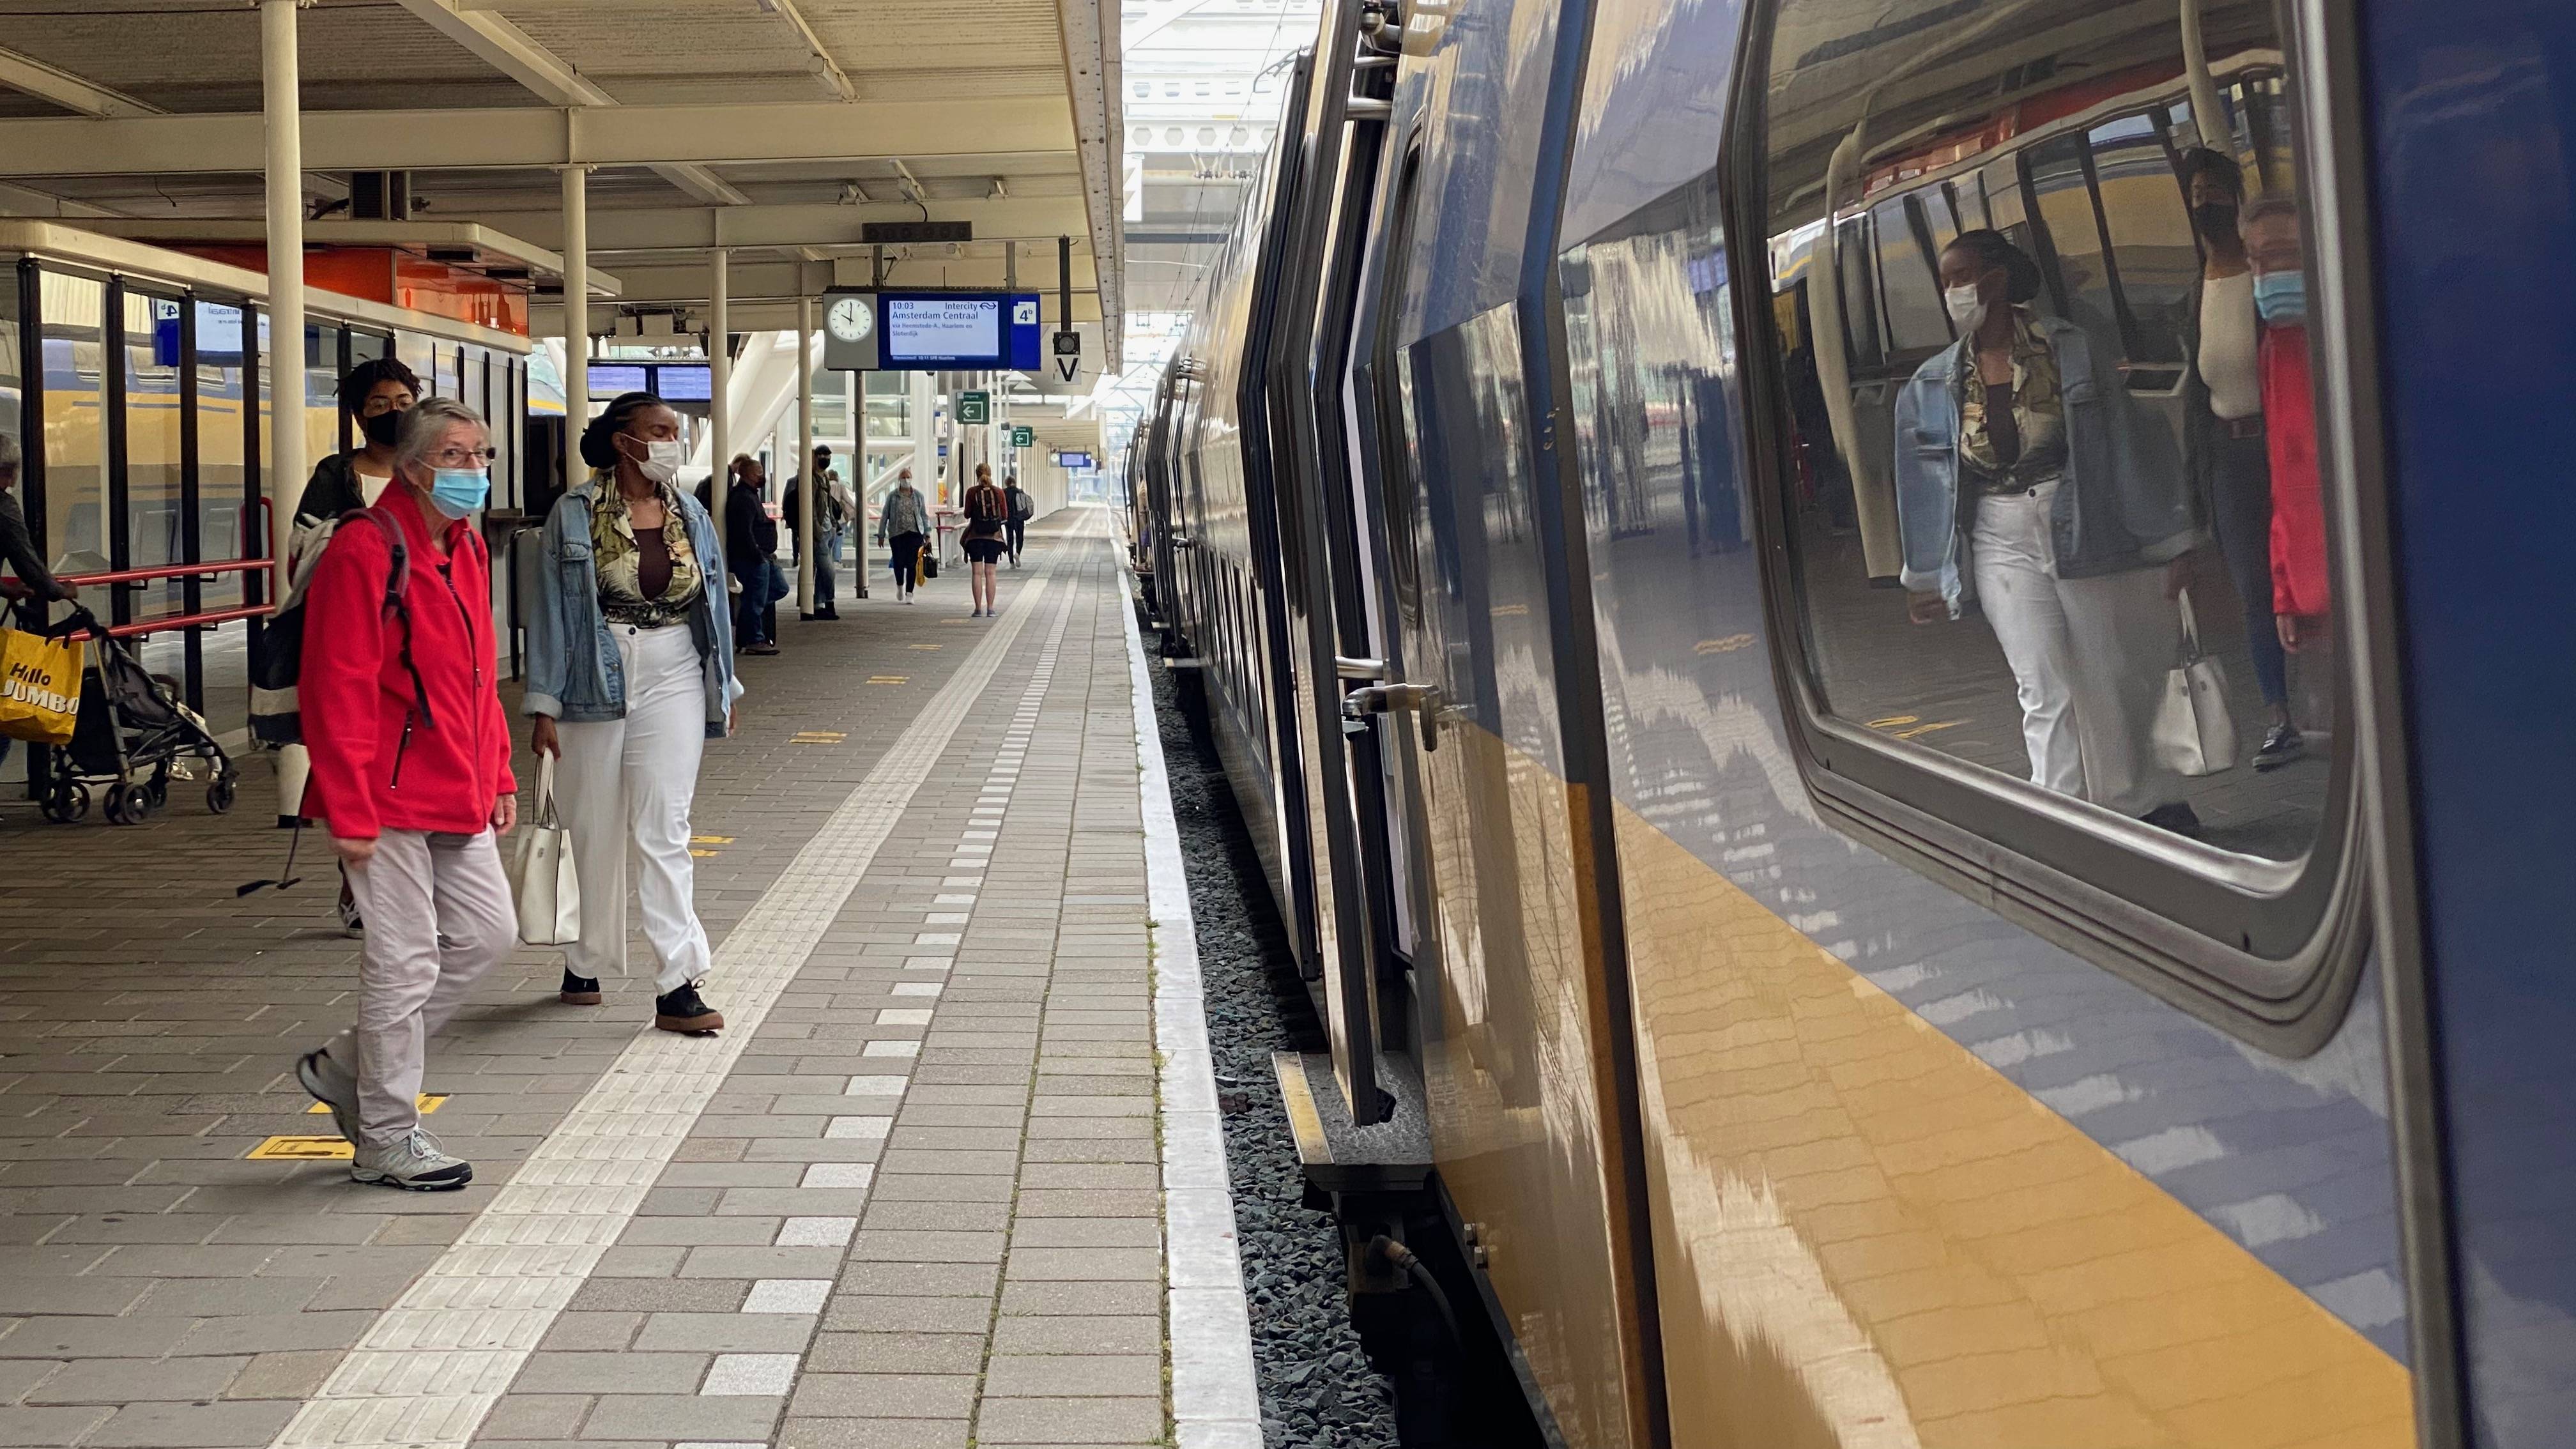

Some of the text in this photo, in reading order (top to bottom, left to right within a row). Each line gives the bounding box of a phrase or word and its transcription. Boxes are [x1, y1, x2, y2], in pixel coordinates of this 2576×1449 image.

[892, 310, 979, 319] Amsterdam Centraal
[945, 302, 977, 312] Intercity
[1056, 357, 1078, 382] V
[0, 678, 79, 715] JUMBO
